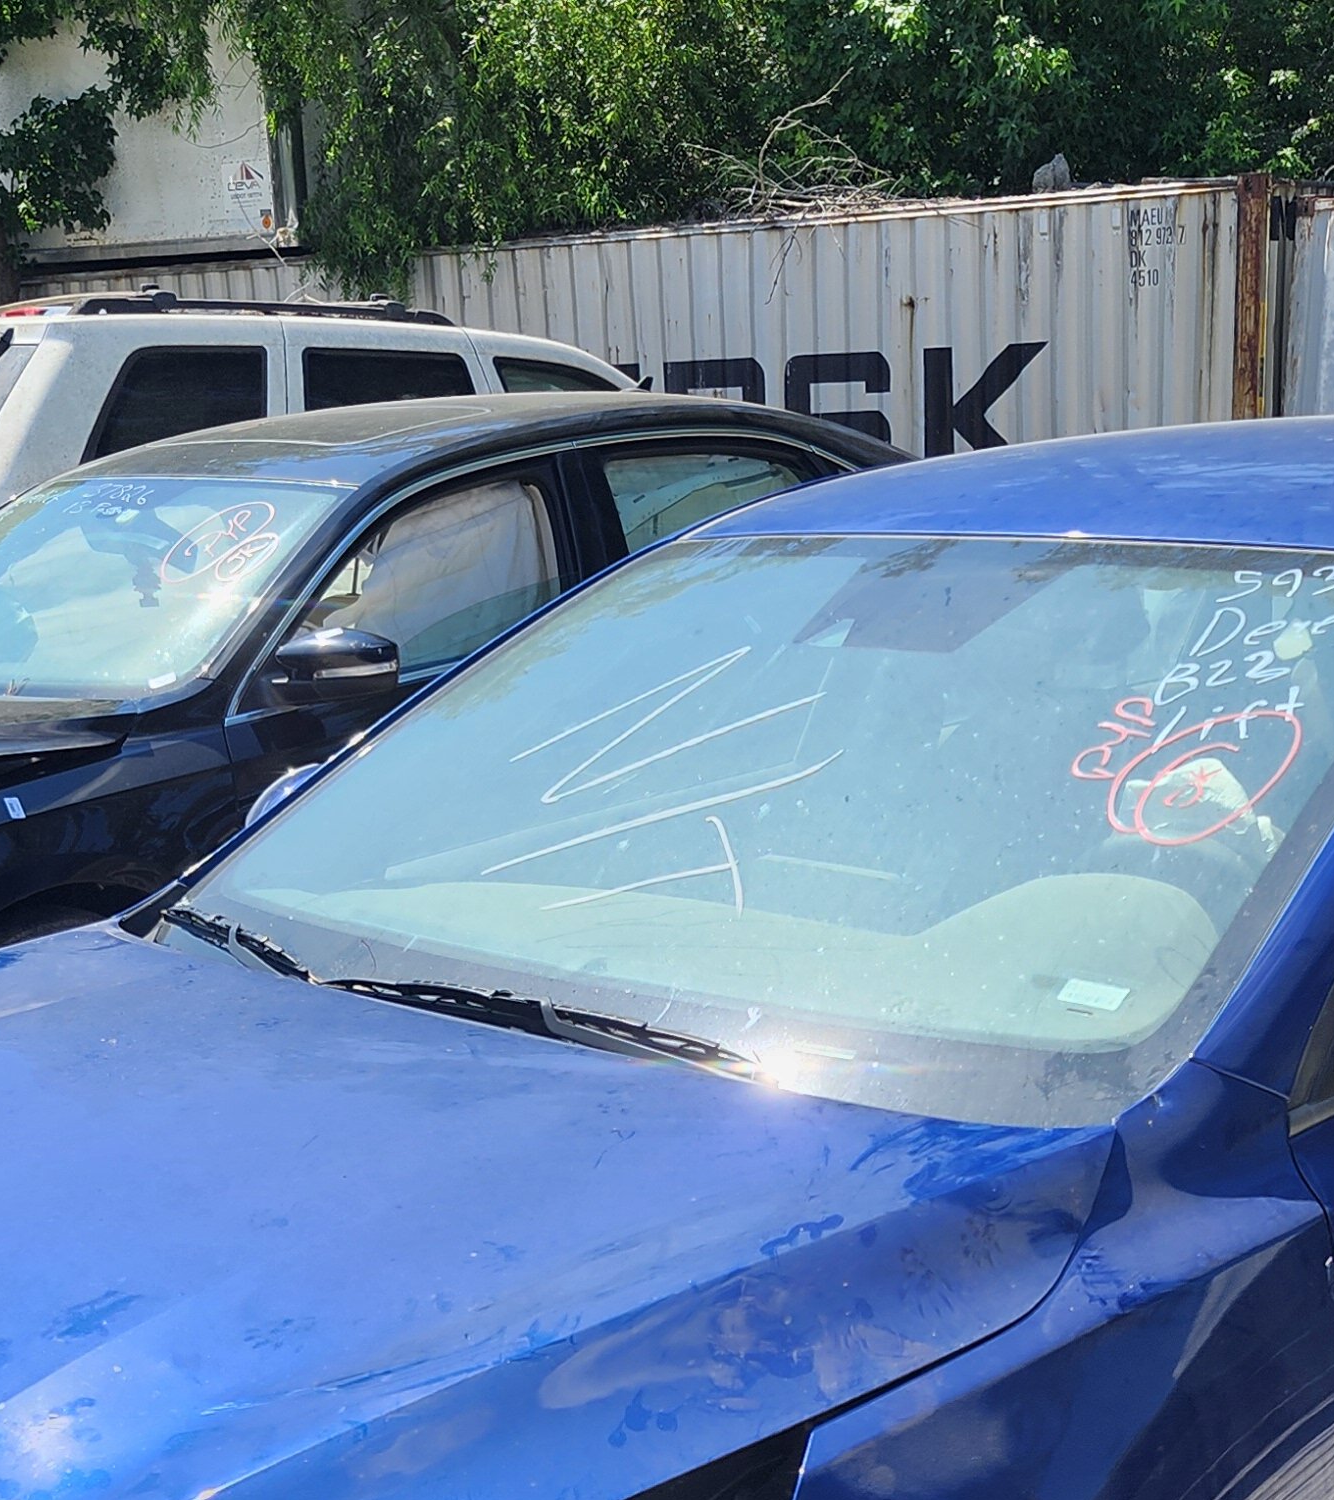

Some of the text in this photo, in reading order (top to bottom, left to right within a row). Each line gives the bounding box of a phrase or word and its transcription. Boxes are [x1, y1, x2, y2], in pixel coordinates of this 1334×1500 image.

[1130, 206, 1163, 227] MAEU
[1130, 228, 1152, 247] 812
[1130, 250, 1147, 267] DK
[1130, 269, 1159, 287] 4510
